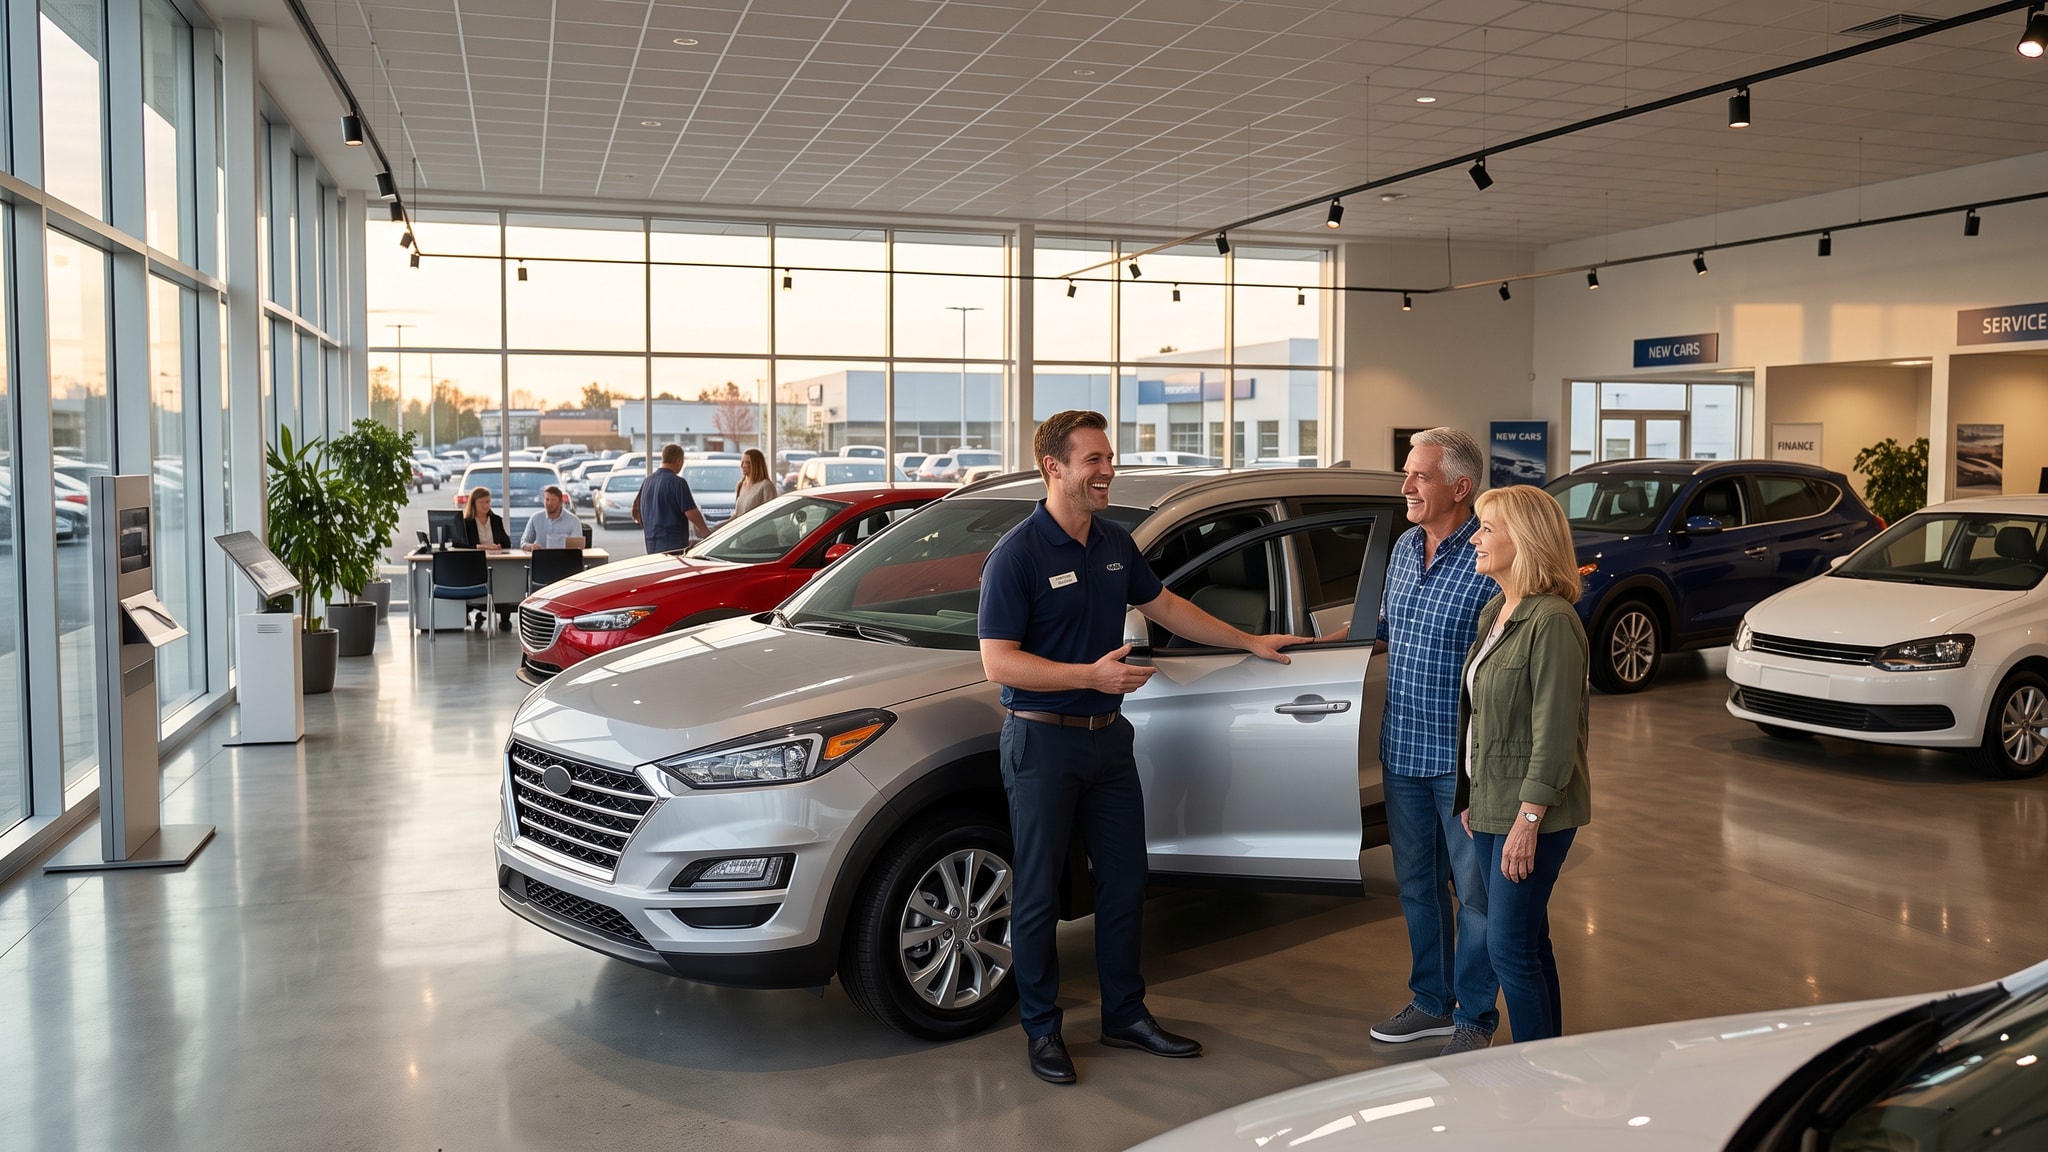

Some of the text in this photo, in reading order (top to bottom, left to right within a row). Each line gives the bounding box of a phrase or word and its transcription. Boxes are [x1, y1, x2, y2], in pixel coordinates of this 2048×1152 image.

[1982, 313, 2047, 334] SERVICE
[1649, 342, 1700, 359] NEW CARS
[1496, 432, 1542, 440] NEW CARS
[1777, 441, 1814, 450] FINANCE
